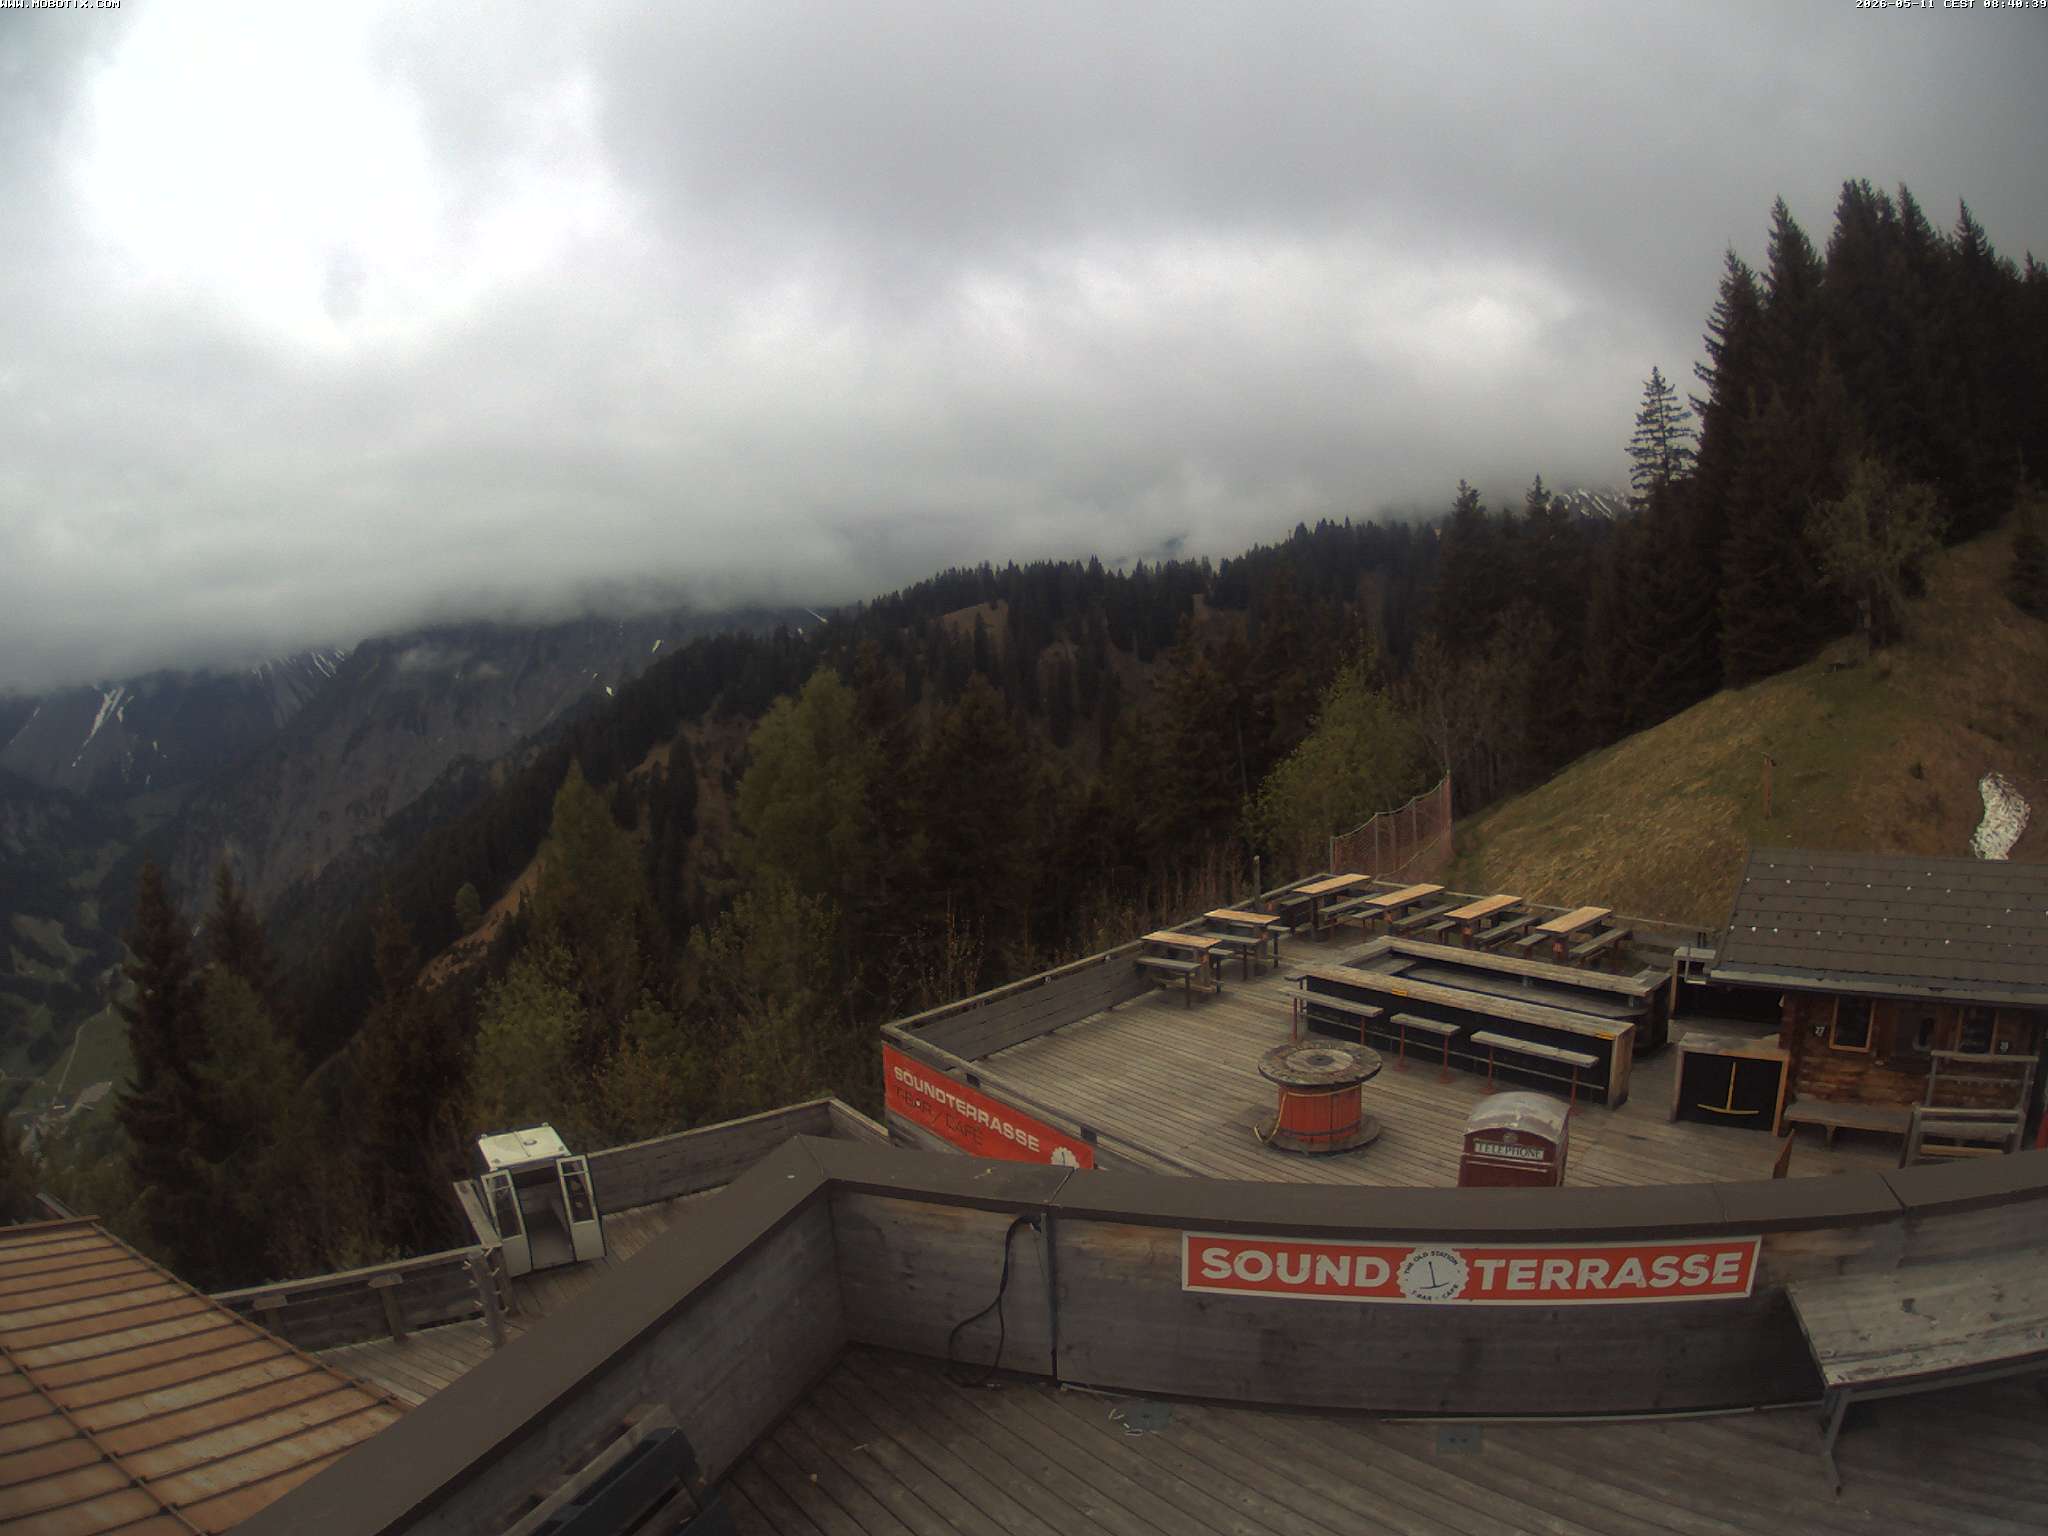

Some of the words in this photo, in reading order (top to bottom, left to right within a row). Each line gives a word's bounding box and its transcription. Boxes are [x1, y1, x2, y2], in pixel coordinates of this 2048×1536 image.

[893, 1065, 1040, 1153] SOUNDTERRASSE
[1477, 1142, 1541, 1158] TELEPHONE
[1201, 1247, 1390, 1288] SOUND
[1473, 1252, 1743, 1291] TERRASSE
[1413, 1251, 1429, 1262] OLD
[1430, 1250, 1458, 1266] STATION
